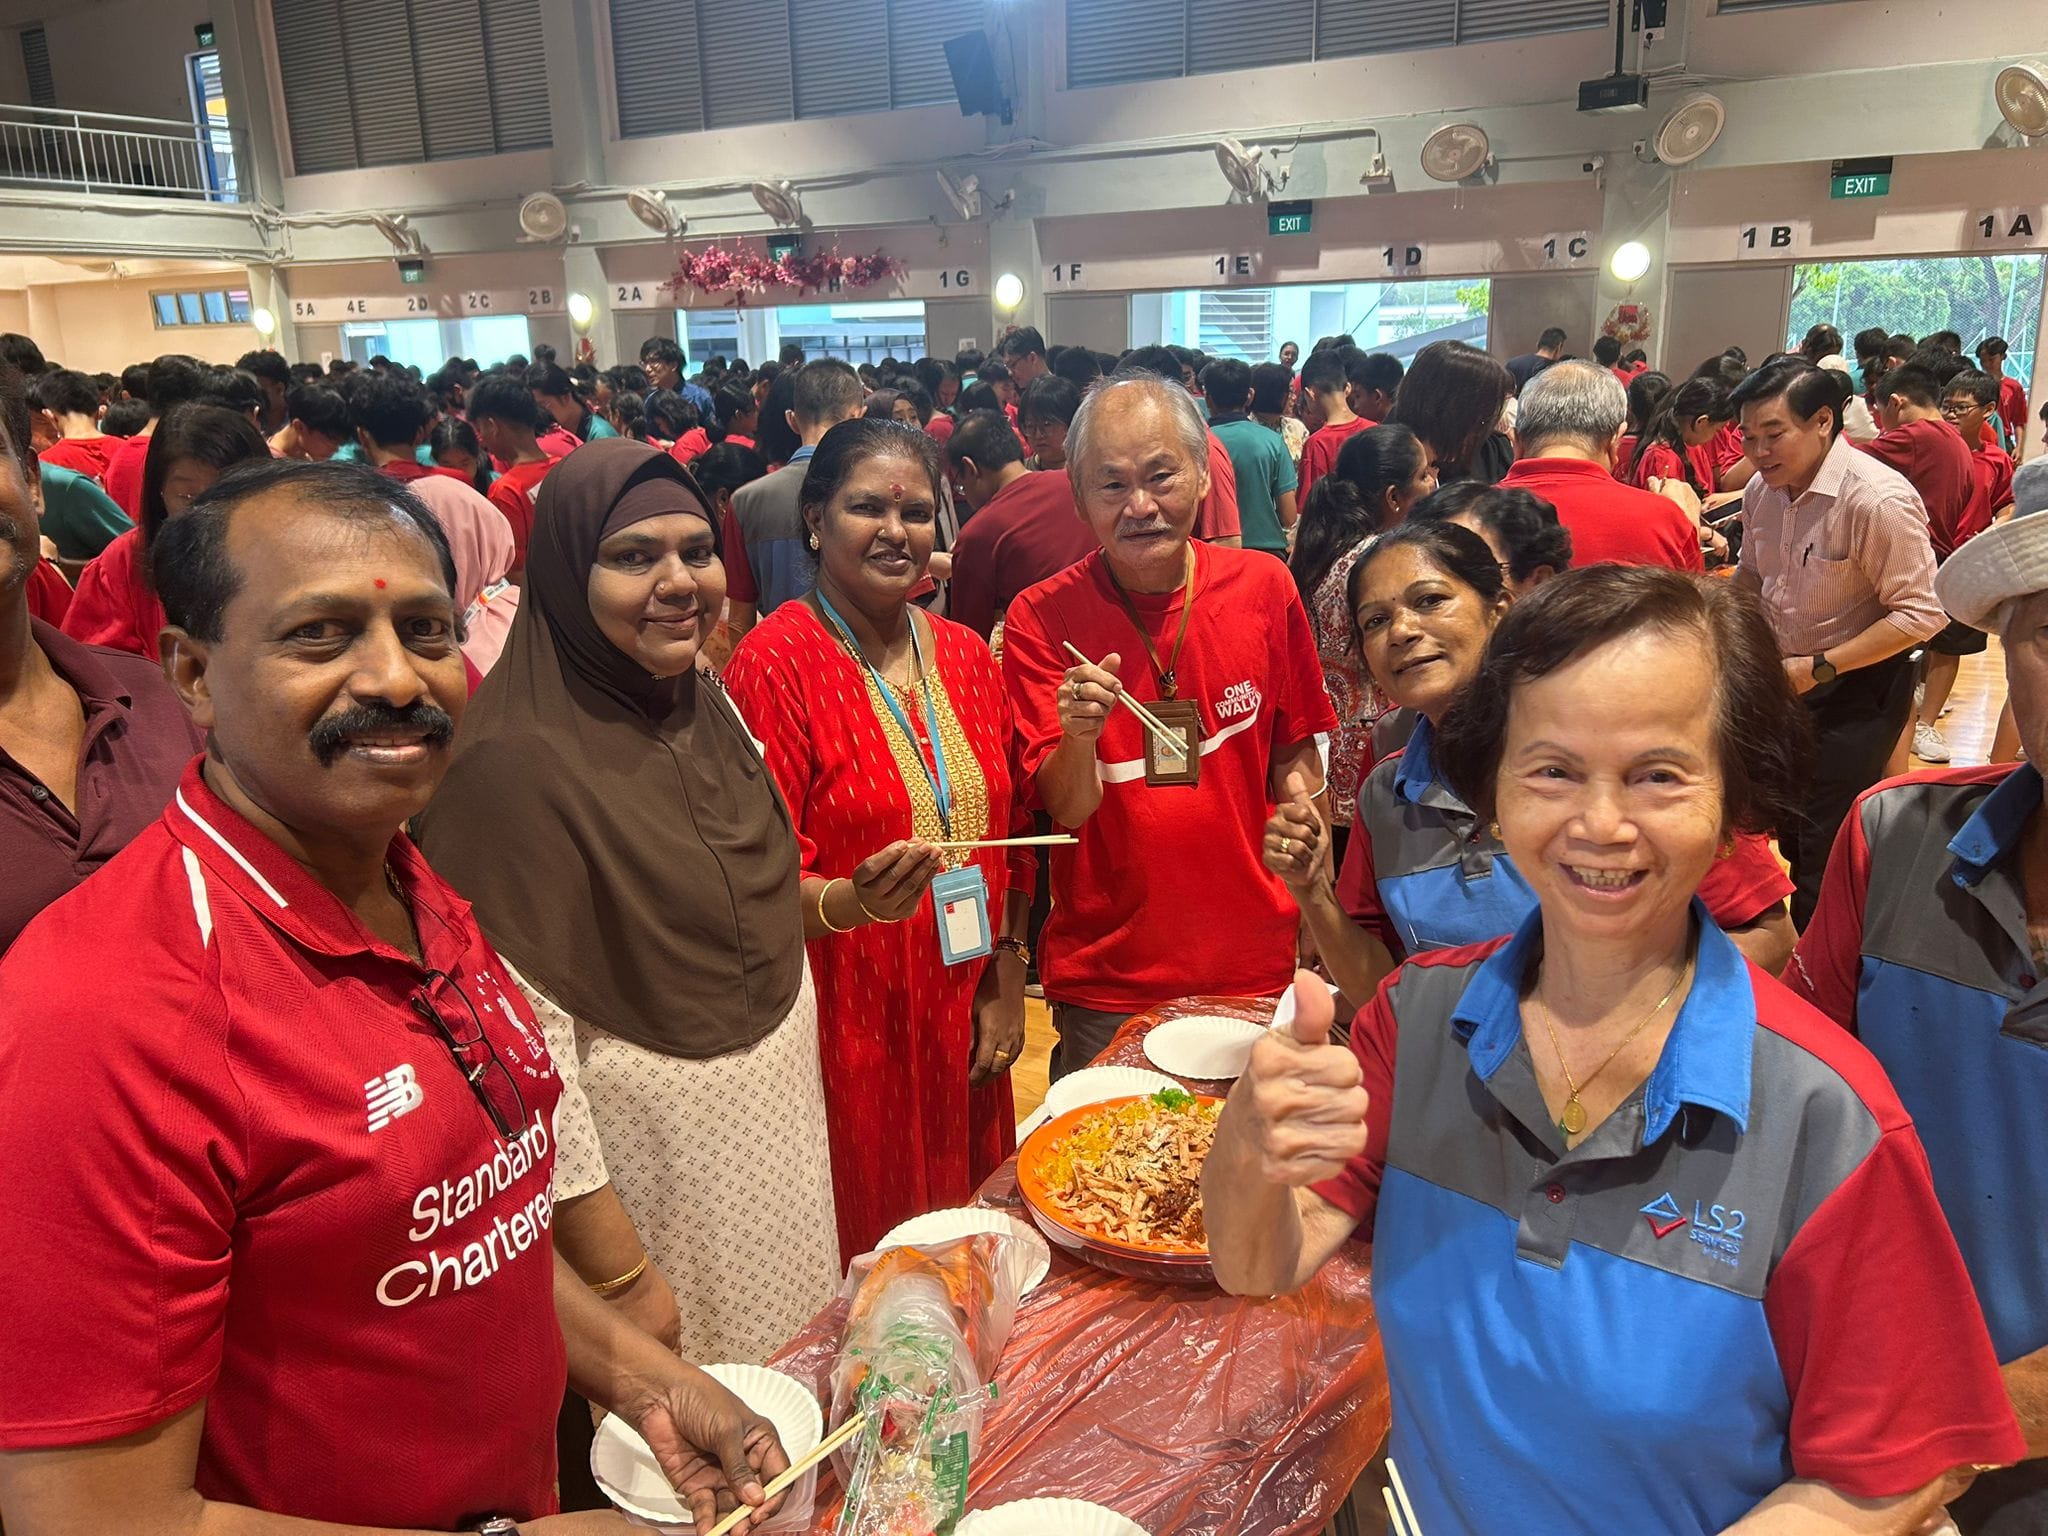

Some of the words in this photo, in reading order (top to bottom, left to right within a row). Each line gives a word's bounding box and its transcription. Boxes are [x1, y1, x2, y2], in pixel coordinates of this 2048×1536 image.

[1844, 176, 1876, 195] EXIT
[1278, 216, 1302, 232] EXIT
[1223, 680, 1252, 699] ONE
[1216, 697, 1257, 719] WALK
[408, 1109, 548, 1242] Standard
[1692, 1199, 1746, 1240] LS2
